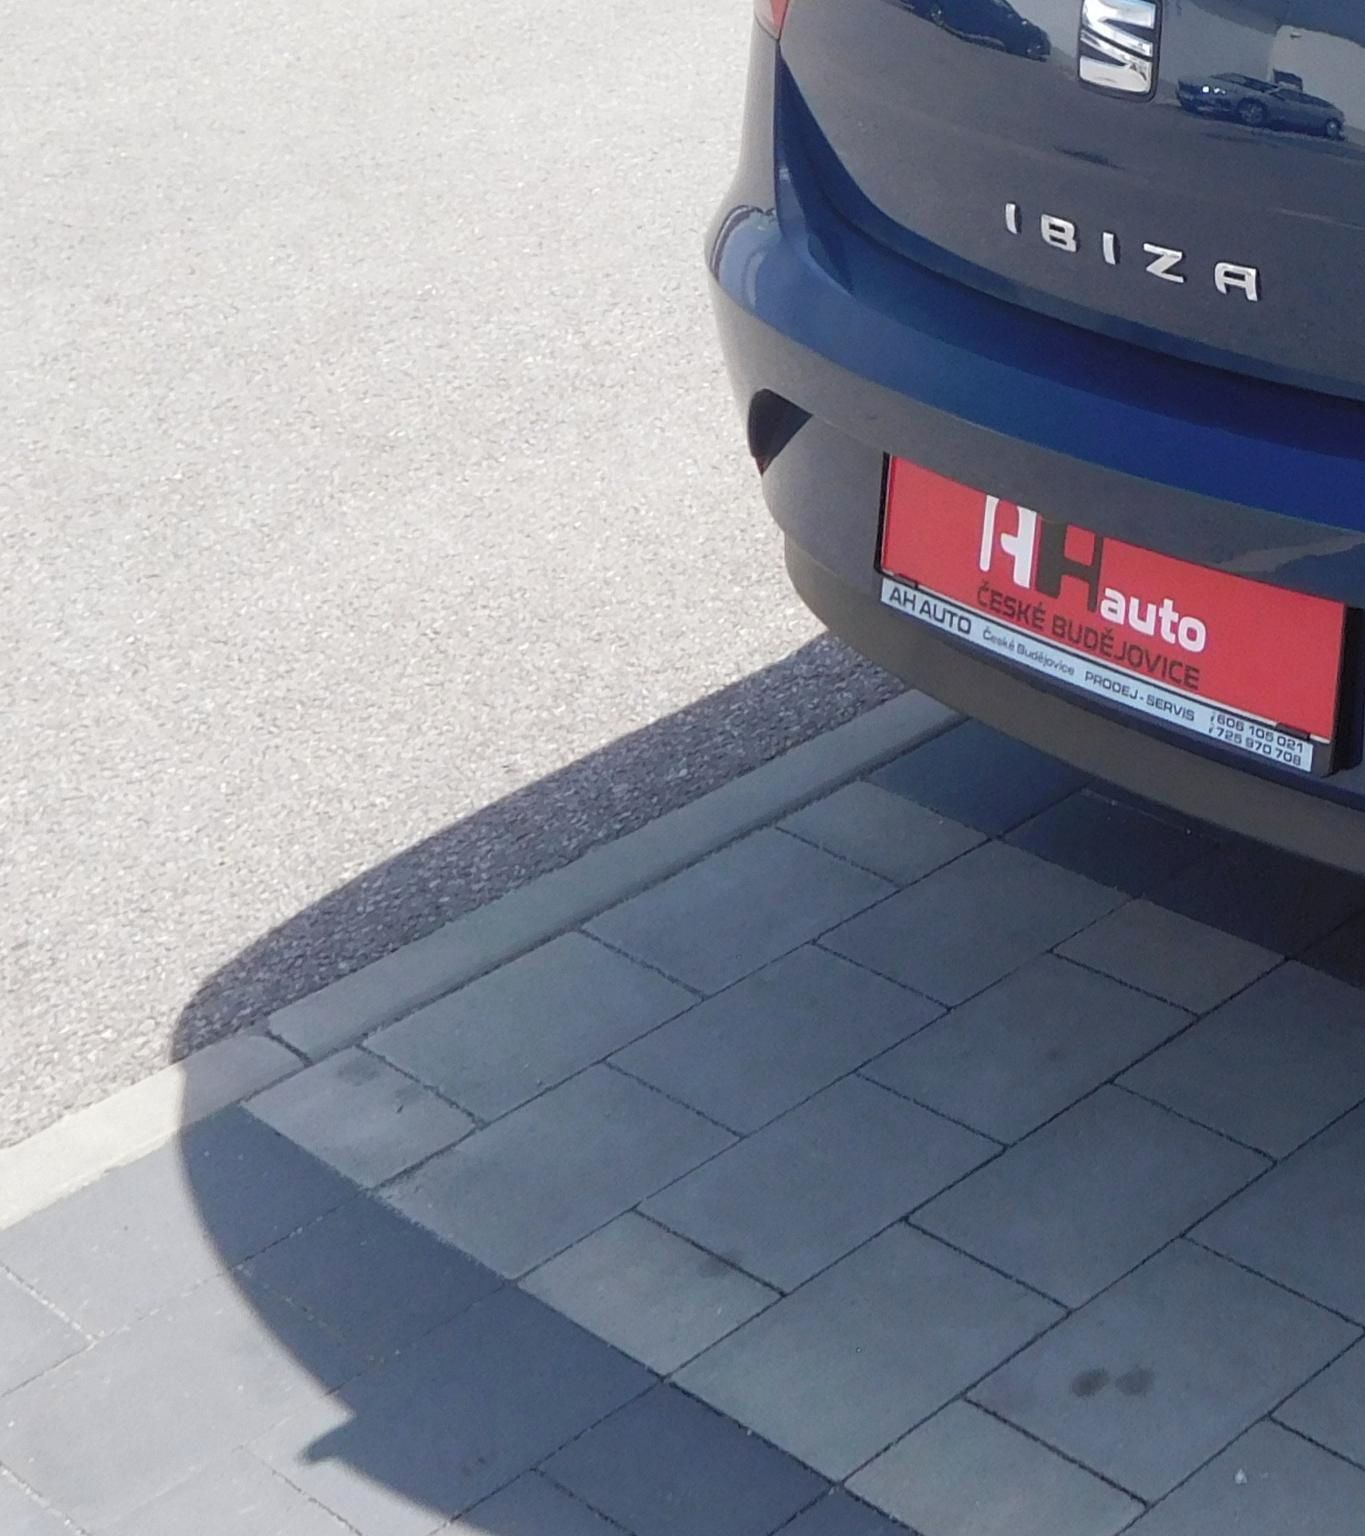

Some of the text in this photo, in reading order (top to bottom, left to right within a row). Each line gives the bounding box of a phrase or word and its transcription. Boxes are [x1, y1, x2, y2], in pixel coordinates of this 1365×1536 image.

[1004, 202, 1258, 302] IBIZA
[889, 586, 917, 611] AH
[919, 600, 972, 635] AUTO
[982, 625, 1016, 652] České
[1016, 642, 1075, 676] Budějovice
[1085, 670, 1138, 700] PRODEJ
[1146, 693, 1195, 722] SERVIS
[976, 579, 1200, 691] ČESKÉ BUDĚJOVICE
[1216, 714, 1304, 753] 606 105 021
[1216, 726, 1242, 746] 725
[1275, 747, 1302, 767] 708
